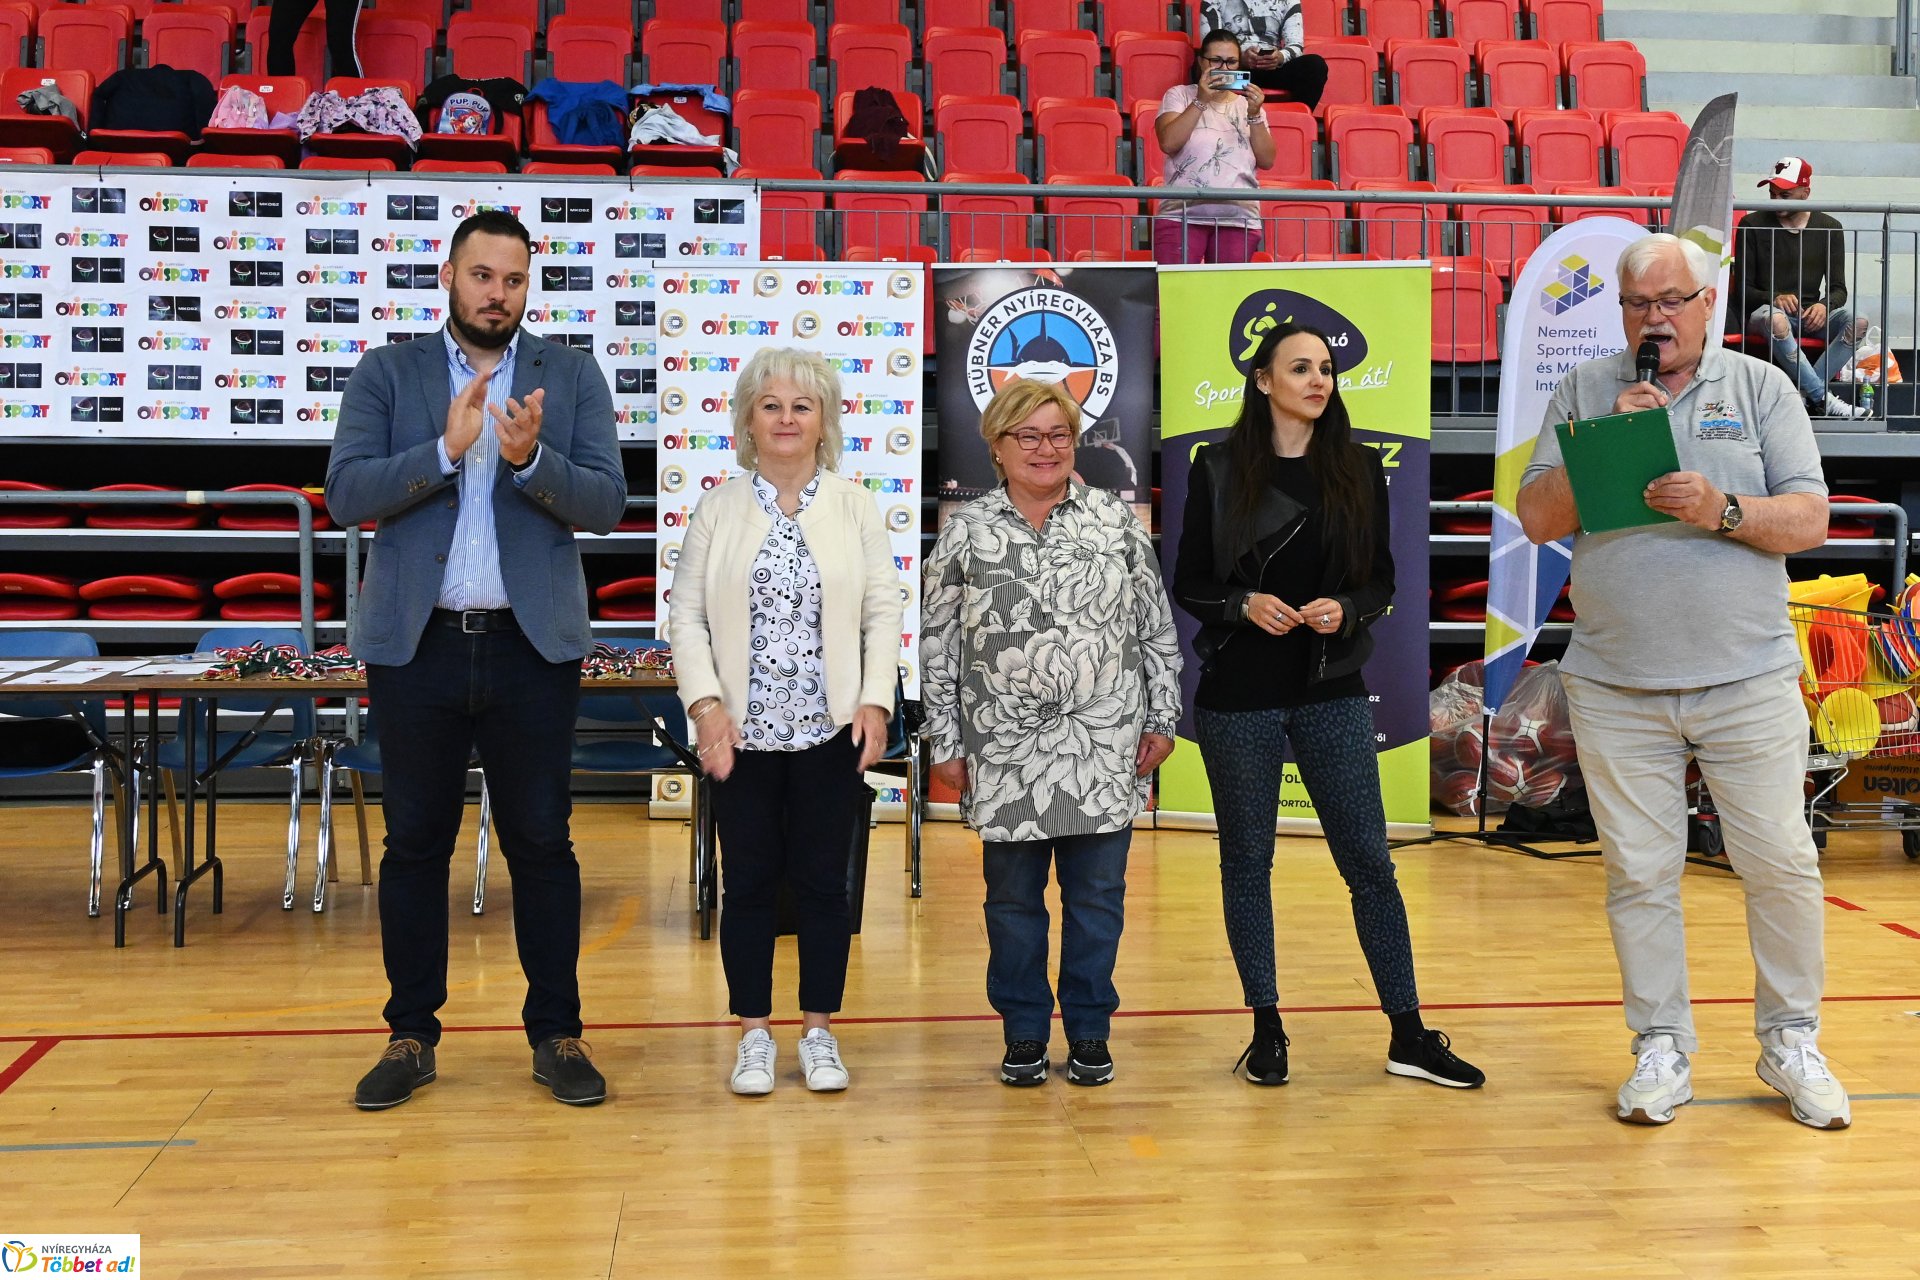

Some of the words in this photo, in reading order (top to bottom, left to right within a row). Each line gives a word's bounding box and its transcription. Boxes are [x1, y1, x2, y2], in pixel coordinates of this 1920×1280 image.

[1537, 325, 1597, 338] Nemzeti
[968, 315, 1002, 395] HÜBNER
[1003, 290, 1113, 365] NYÍREGYHÁZA
[1096, 373, 1113, 397] BS
[1536, 343, 1624, 360] Sportfejles
[1360, 360, 1393, 387] át!
[1536, 362, 1553, 374] és
[1863, 775, 1920, 796] olten
